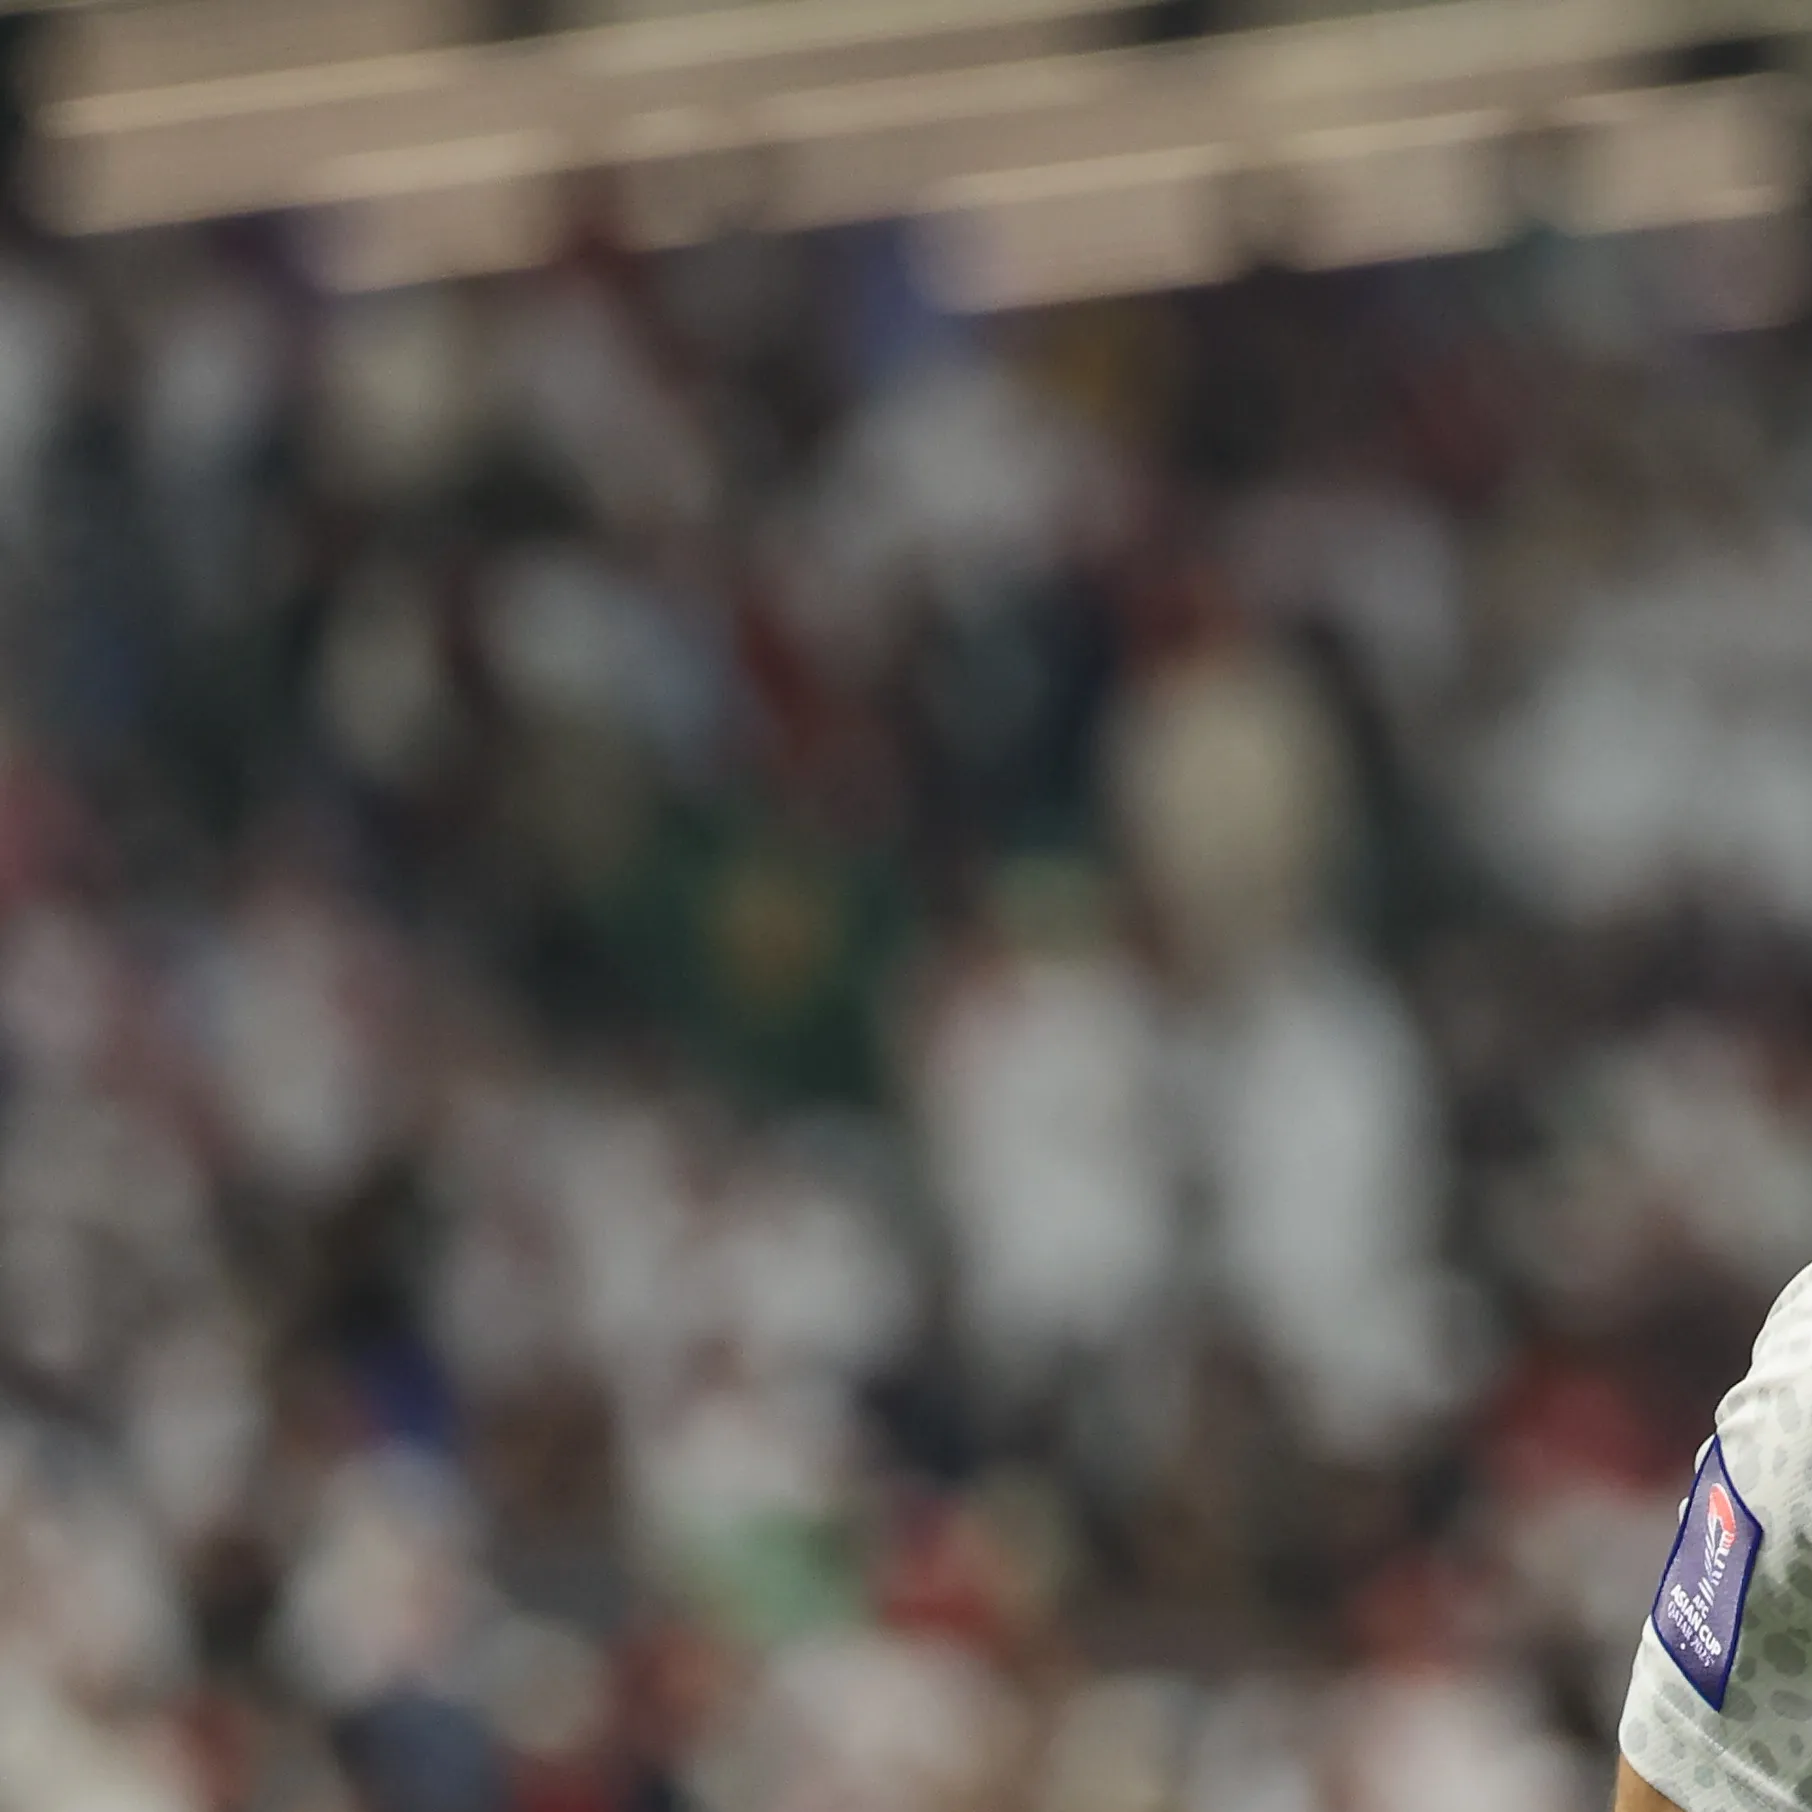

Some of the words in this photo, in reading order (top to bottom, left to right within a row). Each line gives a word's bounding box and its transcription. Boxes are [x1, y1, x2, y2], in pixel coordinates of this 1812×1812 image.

[1667, 1601, 1693, 1640] QATAR
[1670, 1583, 1702, 1632] ASIAN
[1699, 1624, 1721, 1656] CUP
[1693, 1594, 1709, 1620] AFC
